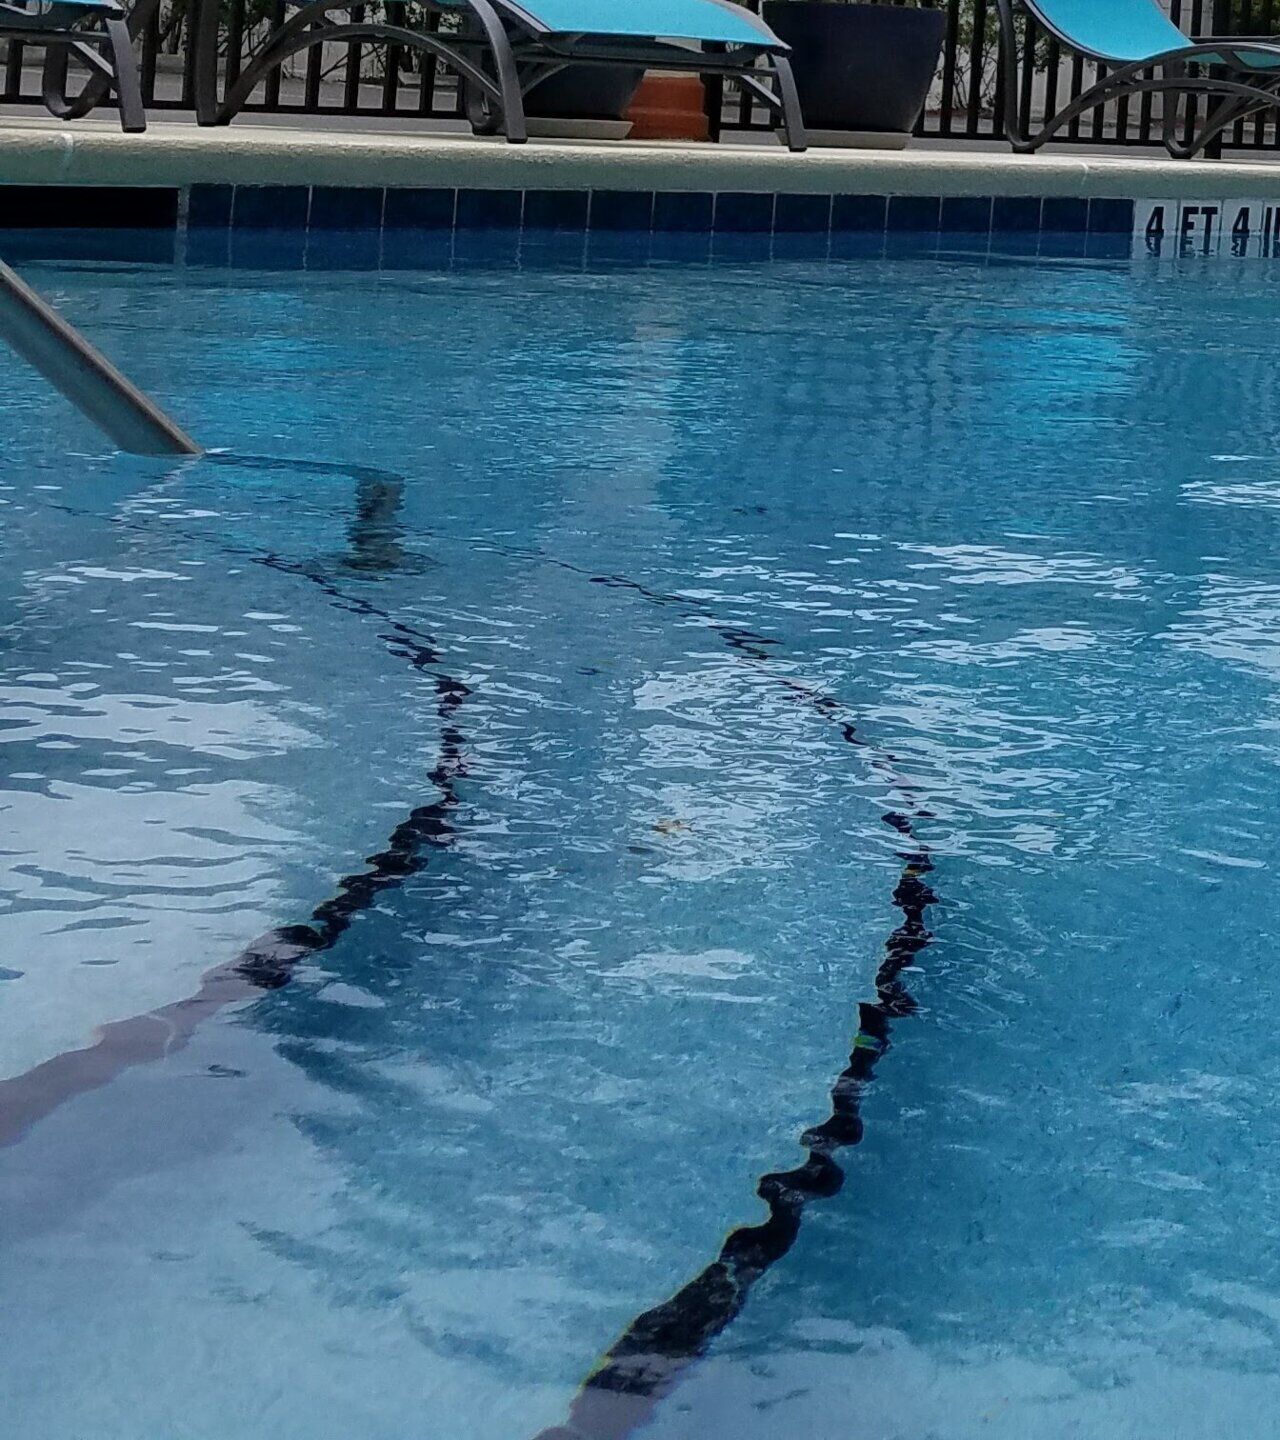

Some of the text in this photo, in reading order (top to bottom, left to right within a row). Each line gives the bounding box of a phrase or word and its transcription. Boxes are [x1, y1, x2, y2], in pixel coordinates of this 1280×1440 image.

[1145, 206, 1164, 236] 4
[1181, 206, 1218, 236] FT
[1232, 206, 1250, 236] 4
